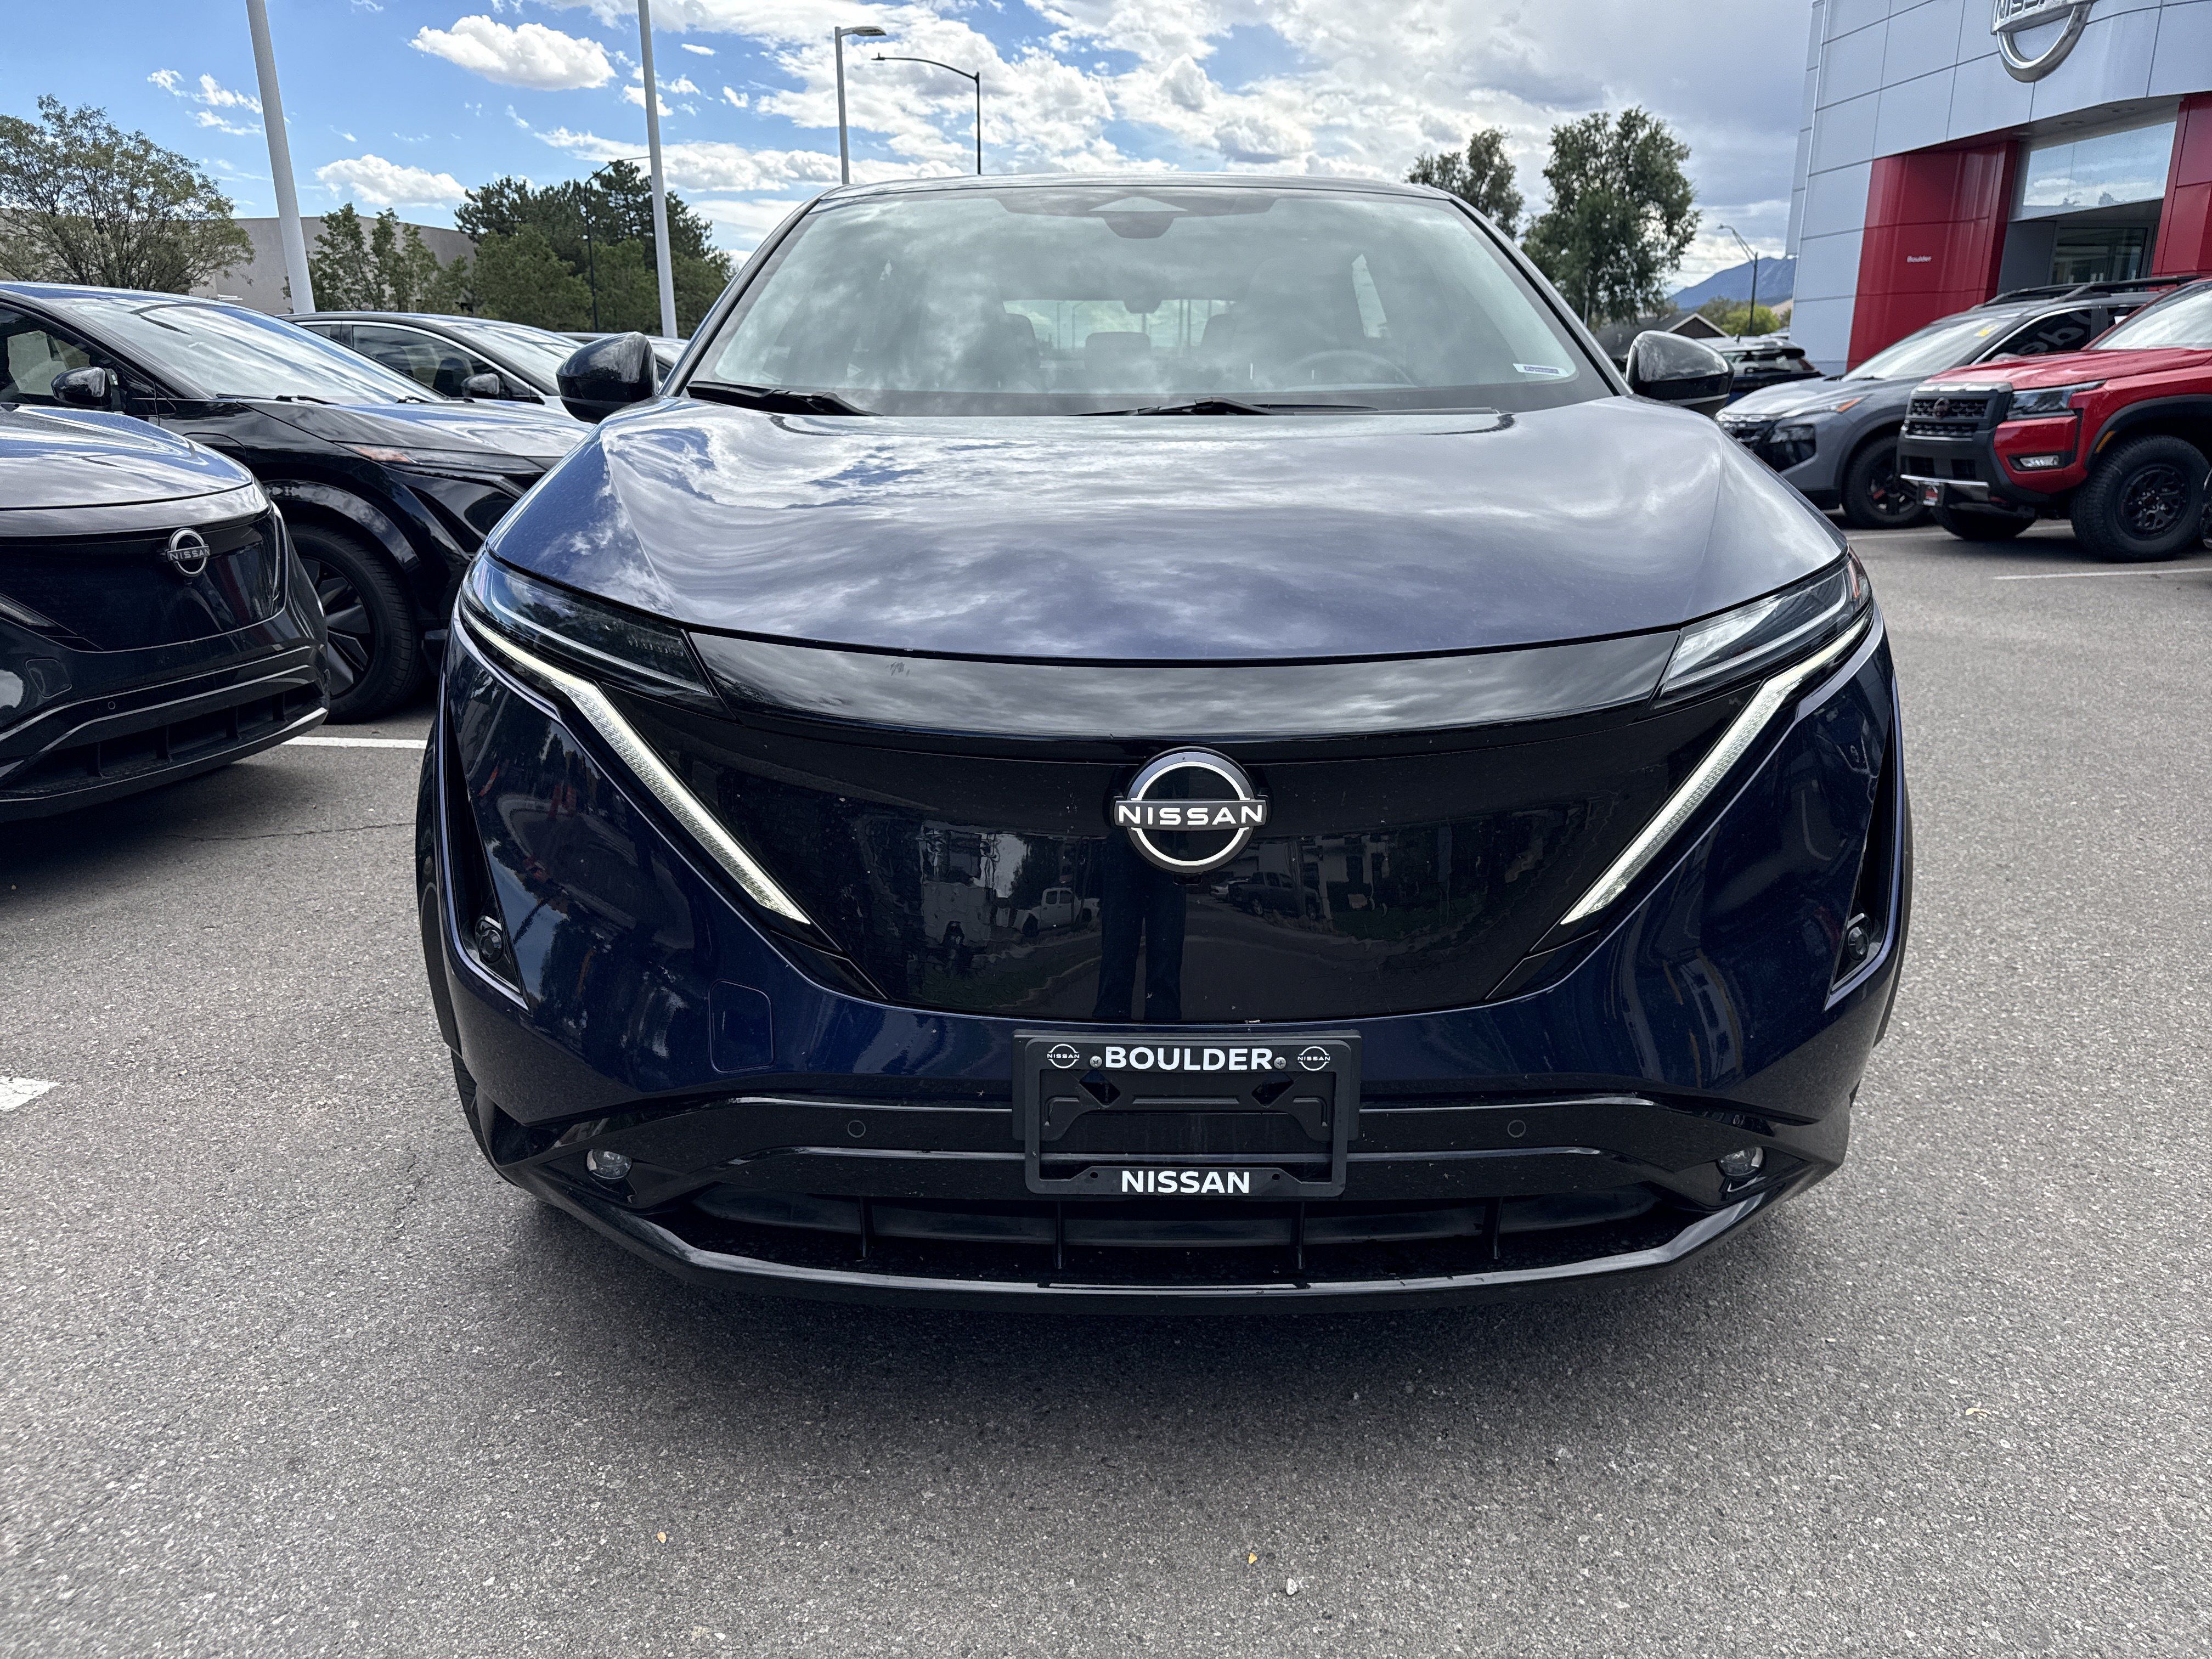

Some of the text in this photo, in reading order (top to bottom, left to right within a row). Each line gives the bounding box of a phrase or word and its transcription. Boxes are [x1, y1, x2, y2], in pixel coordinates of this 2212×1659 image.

[170, 548, 210, 561] NISSAN
[1119, 805, 1262, 825] NISSAN
[1105, 1046, 1272, 1070] BOULDER
[1122, 1171, 1250, 1193] NISSAN
